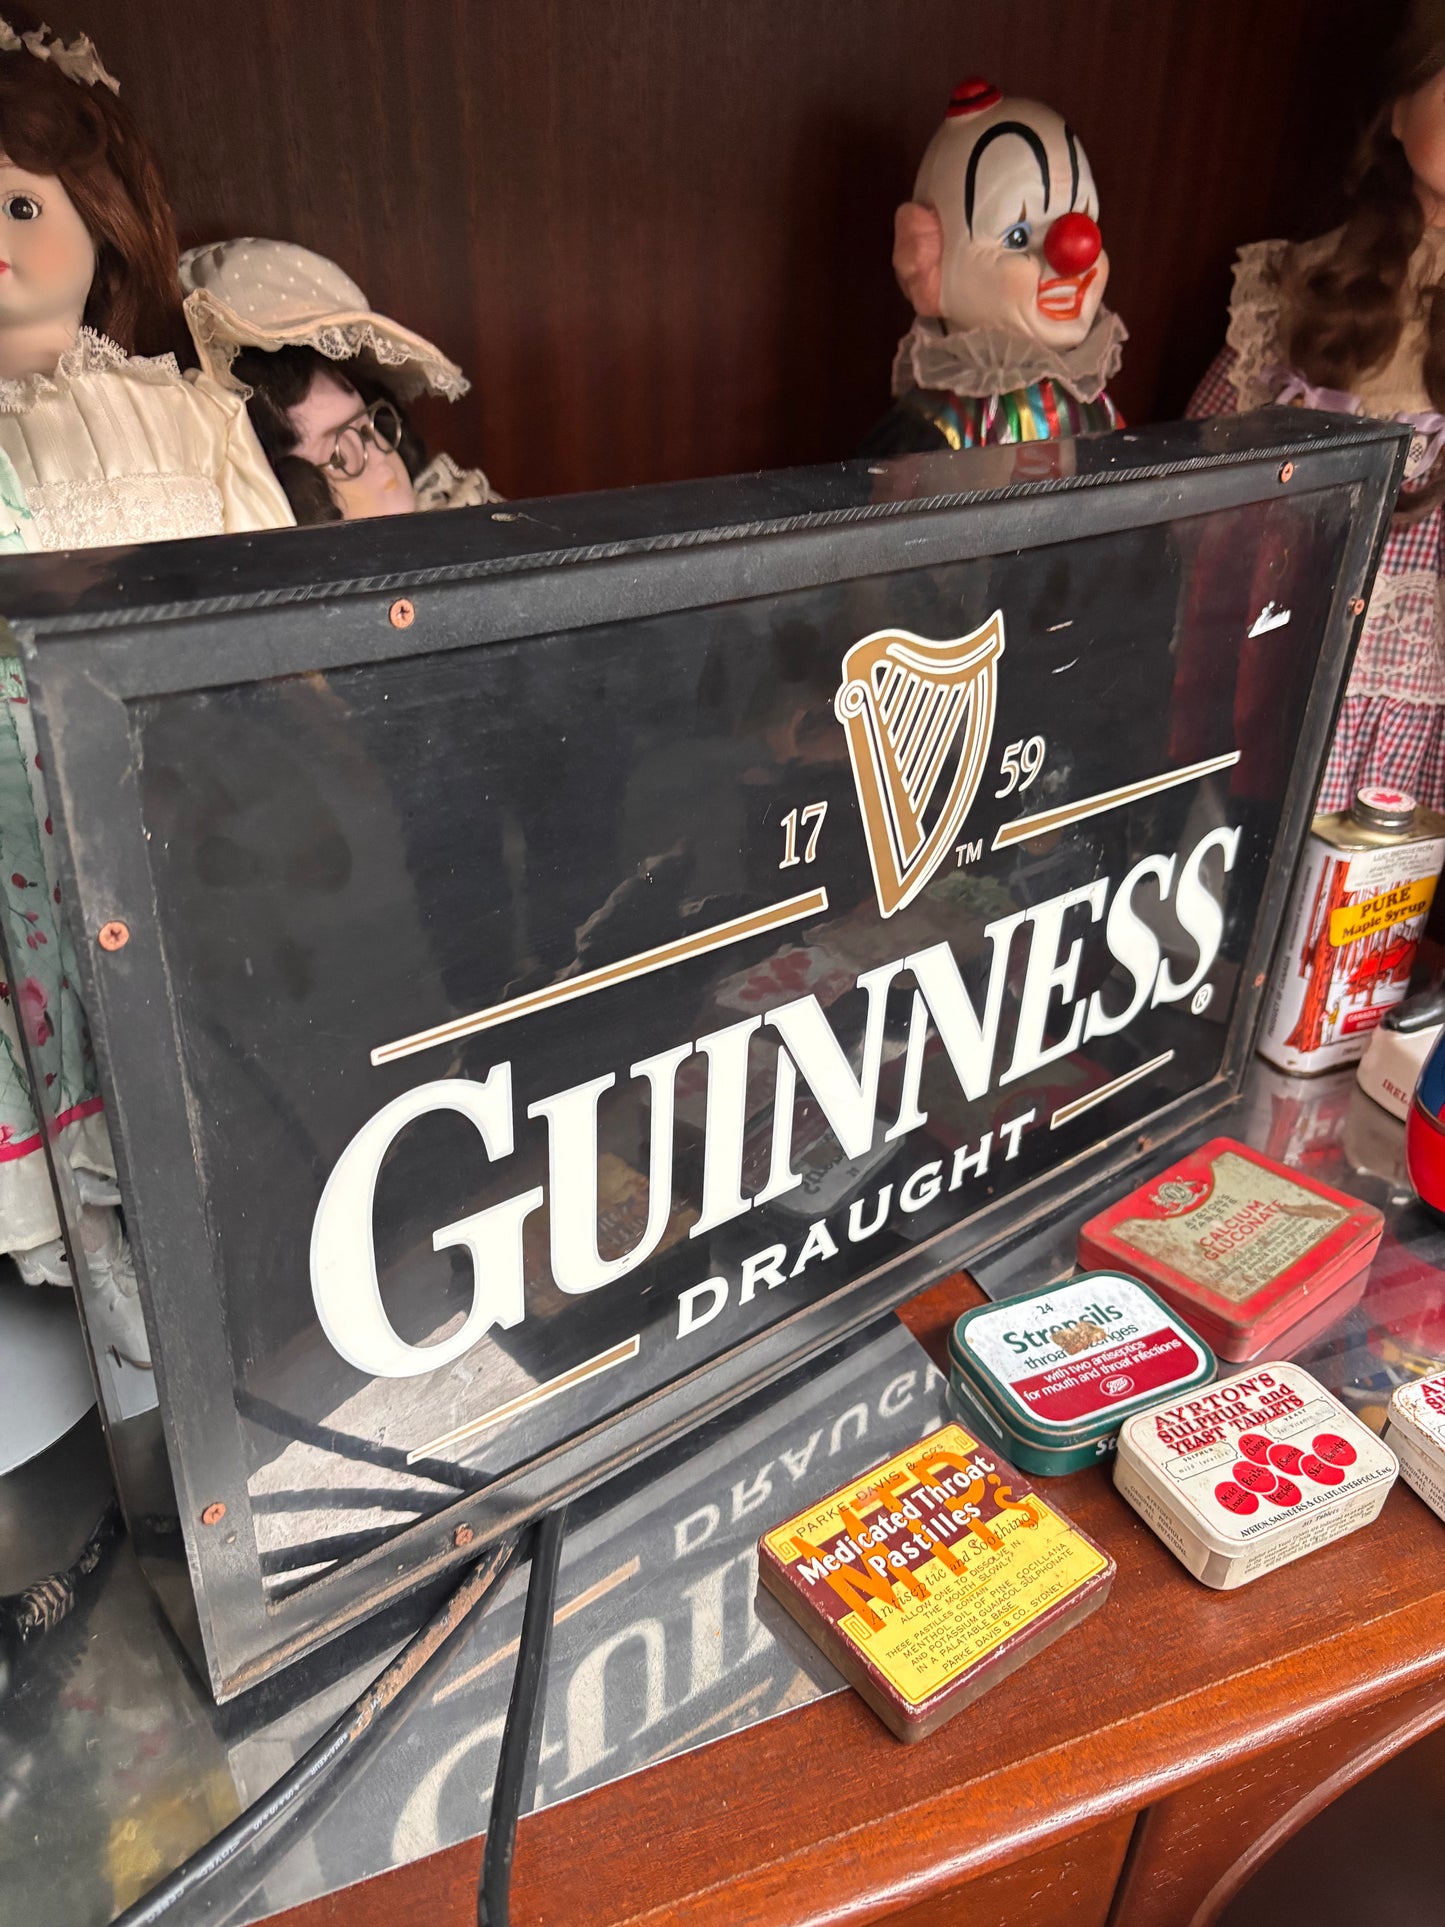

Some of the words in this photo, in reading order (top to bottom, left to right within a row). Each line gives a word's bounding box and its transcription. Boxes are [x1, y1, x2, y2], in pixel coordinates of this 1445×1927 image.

[779, 801, 828, 869] 17
[995, 735, 1045, 798] 59
[956, 838, 983, 867] TM
[1342, 916, 1381, 940] Maple
[1385, 901, 1426, 922] Syrup
[1360, 886, 1411, 919] PURE
[309, 825, 1242, 1380] GUINNESS
[1382, 1078, 1408, 1104] IREL
[676, 1108, 1036, 1340] DRAUGHT
[1199, 1199, 1266, 1249] CALCIUM
[1204, 1199, 1286, 1261] GLUCONATE
[1036, 1302, 1054, 1316] 24
[1023, 1389, 1041, 1402] for
[1042, 1375, 1080, 1396] mouth
[1079, 1368, 1100, 1384] and
[1099, 1357, 1133, 1376] throat
[1131, 1337, 1182, 1364] infections
[1024, 1348, 1068, 1370] throa
[1044, 1368, 1070, 1383] with
[1069, 1360, 1091, 1375] two
[1092, 1339, 1147, 1365] antiseptics
[1154, 1372, 1276, 1431] AYRTON'S
[1157, 1401, 1253, 1444] SULPHUR
[1258, 1383, 1295, 1406] and
[1166, 1426, 1227, 1456] YEAST
[1228, 1393, 1304, 1433] TABLETS
[856, 1470, 900, 1501] DAVIS
[906, 1462, 916, 1471] &
[797, 1498, 922, 1586] Medicated
[910, 1455, 996, 1511] Throat
[867, 1502, 981, 1578] Pastilles
[871, 1568, 947, 1625] Antiseptic
[950, 1554, 971, 1571] and
[968, 1511, 1039, 1556] Soothing
[900, 1600, 932, 1625] ALLOW
[934, 1586, 953, 1601] ONE
[954, 1576, 968, 1587] TO
[969, 1547, 1010, 1577] DISSOLVE
[1010, 1539, 1021, 1549] IN
[886, 1638, 912, 1659] THESE
[913, 1610, 954, 1639] PASTILLES
[956, 1586, 989, 1610] CONTAIN
[903, 1623, 951, 1659] MENTHOL
[954, 1610, 972, 1623] OIL
[973, 1598, 986, 1609] OF
[990, 1579, 1013, 1598] PINE
[1016, 1543, 1067, 1579] COCILLANA
[911, 1652, 928, 1666] AND
[928, 1616, 978, 1652] POTASSIUM
[979, 1586, 1022, 1617] GUAIACOL
[1020, 1548, 1074, 1587] SULPHONATE
[922, 1604, 943, 1619] THE
[944, 1581, 977, 1605] MOUTH
[975, 1626, 1001, 1647] DAVIS
[1002, 1619, 1011, 1628] &
[1030, 1581, 1064, 1608] SYDNEY
[916, 1663, 928, 1674] IN
[930, 1656, 939, 1665] A
[940, 1619, 990, 1657] PALATABLE
